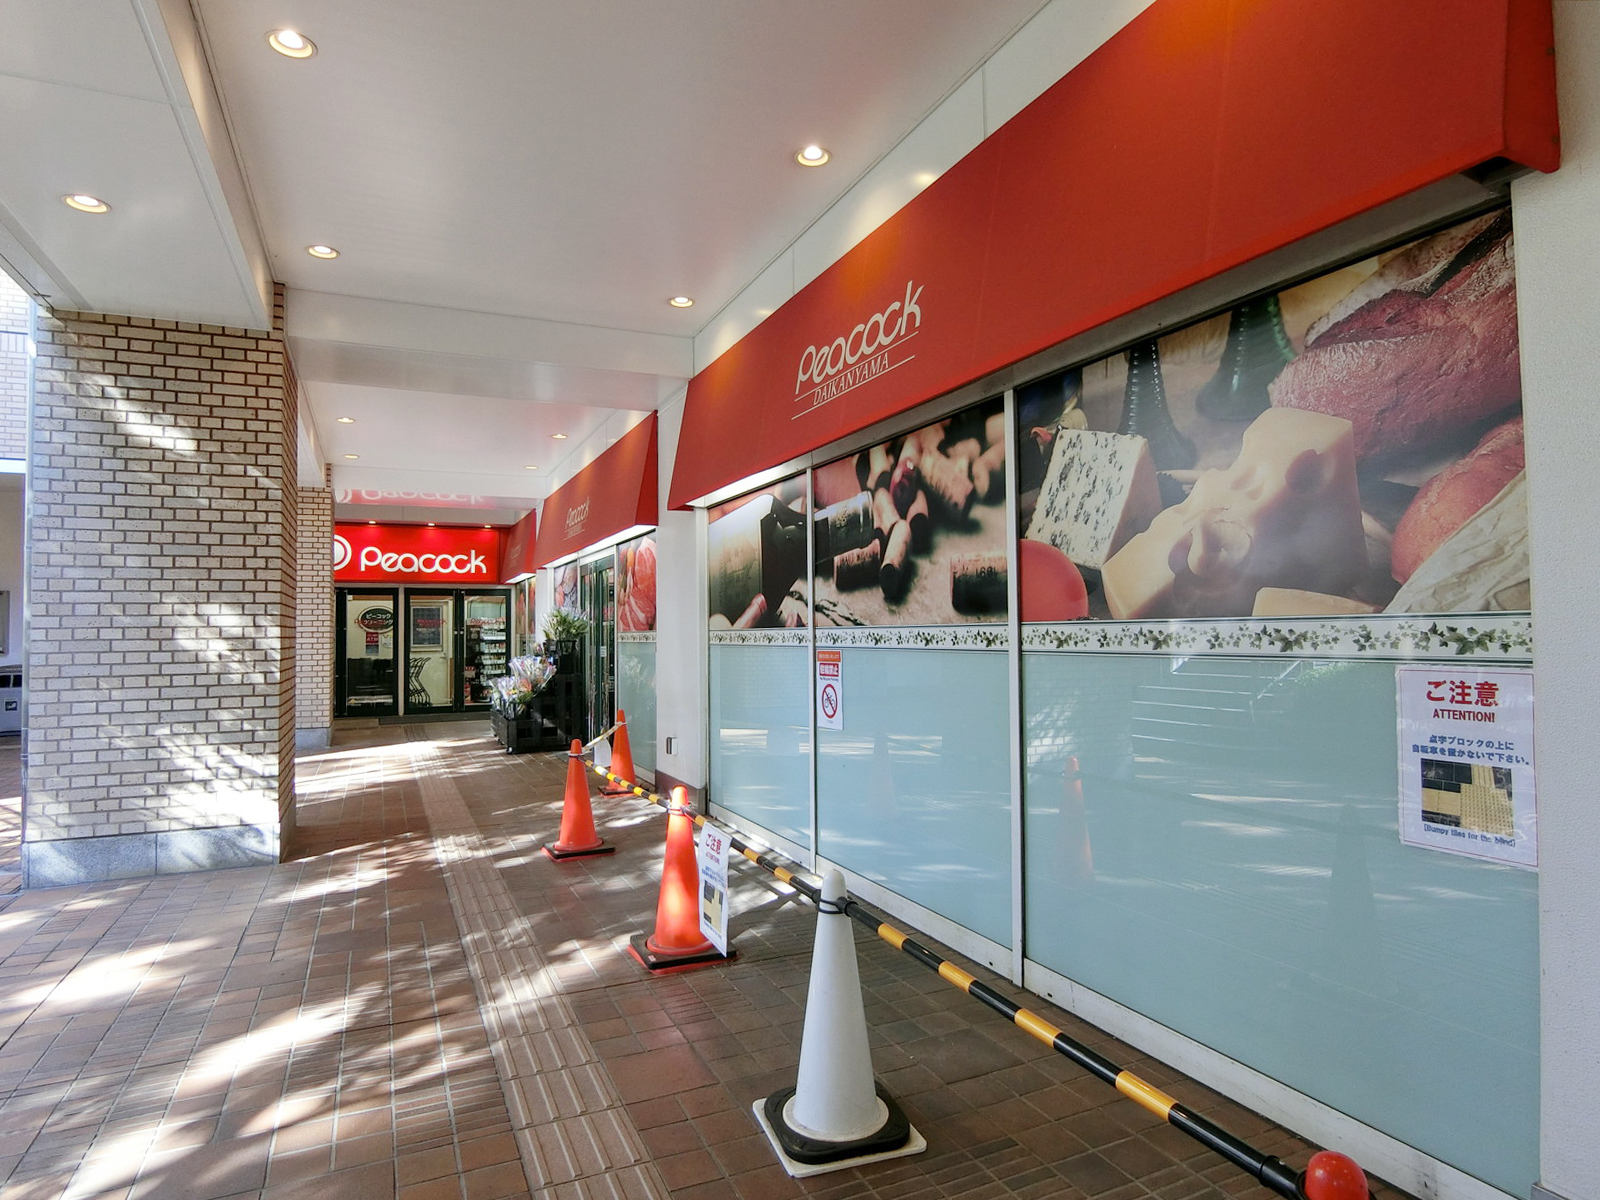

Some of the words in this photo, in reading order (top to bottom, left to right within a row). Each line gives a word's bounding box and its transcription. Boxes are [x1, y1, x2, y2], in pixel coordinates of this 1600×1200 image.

[813, 352, 889, 406] DAIKANYAMA
[1426, 679, 1499, 707] ご注意
[1433, 708, 1495, 723] ATTENTION!
[1429, 734, 1515, 751] 点字ブロックの上に
[1412, 744, 1530, 765] 自転車を置かないで下さい。
[1467, 832, 1479, 840] for
